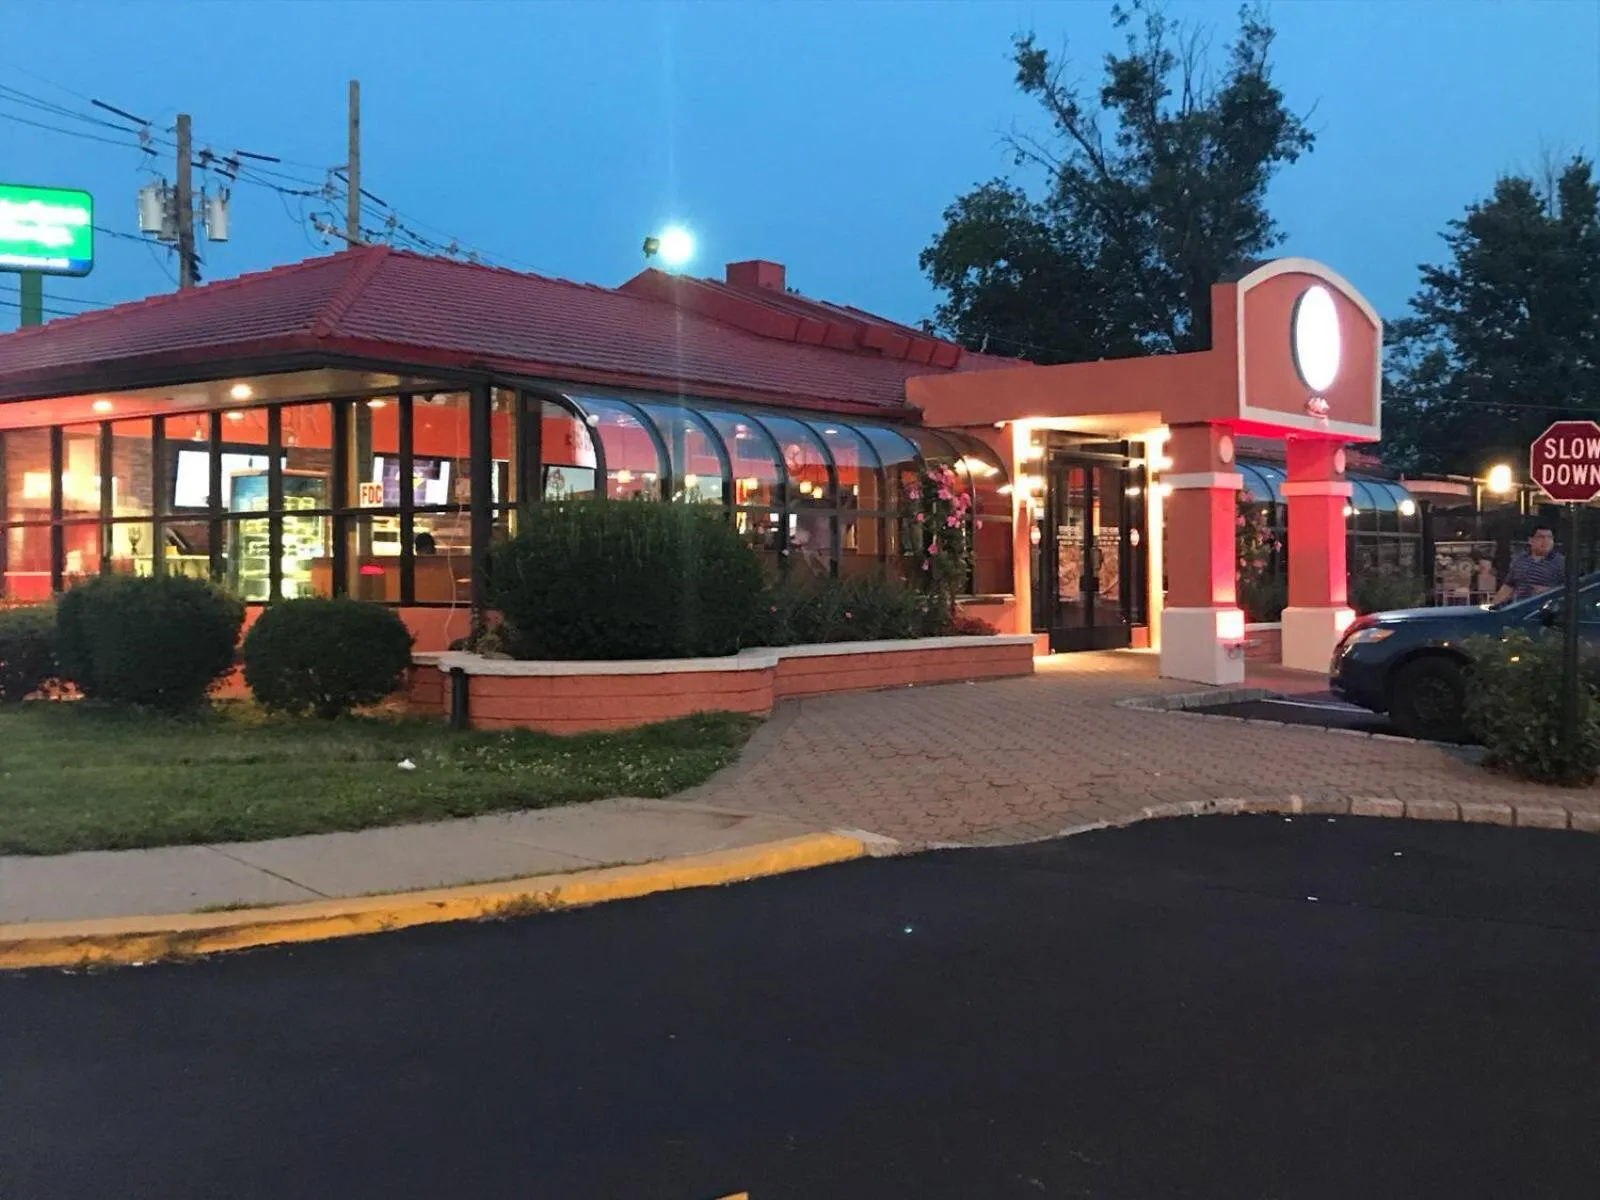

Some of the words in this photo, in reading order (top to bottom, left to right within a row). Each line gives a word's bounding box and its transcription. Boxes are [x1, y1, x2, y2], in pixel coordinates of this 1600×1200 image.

[1544, 438, 1600, 459] SLOW
[1542, 464, 1600, 485] DOWN
[362, 485, 382, 504] FDC
